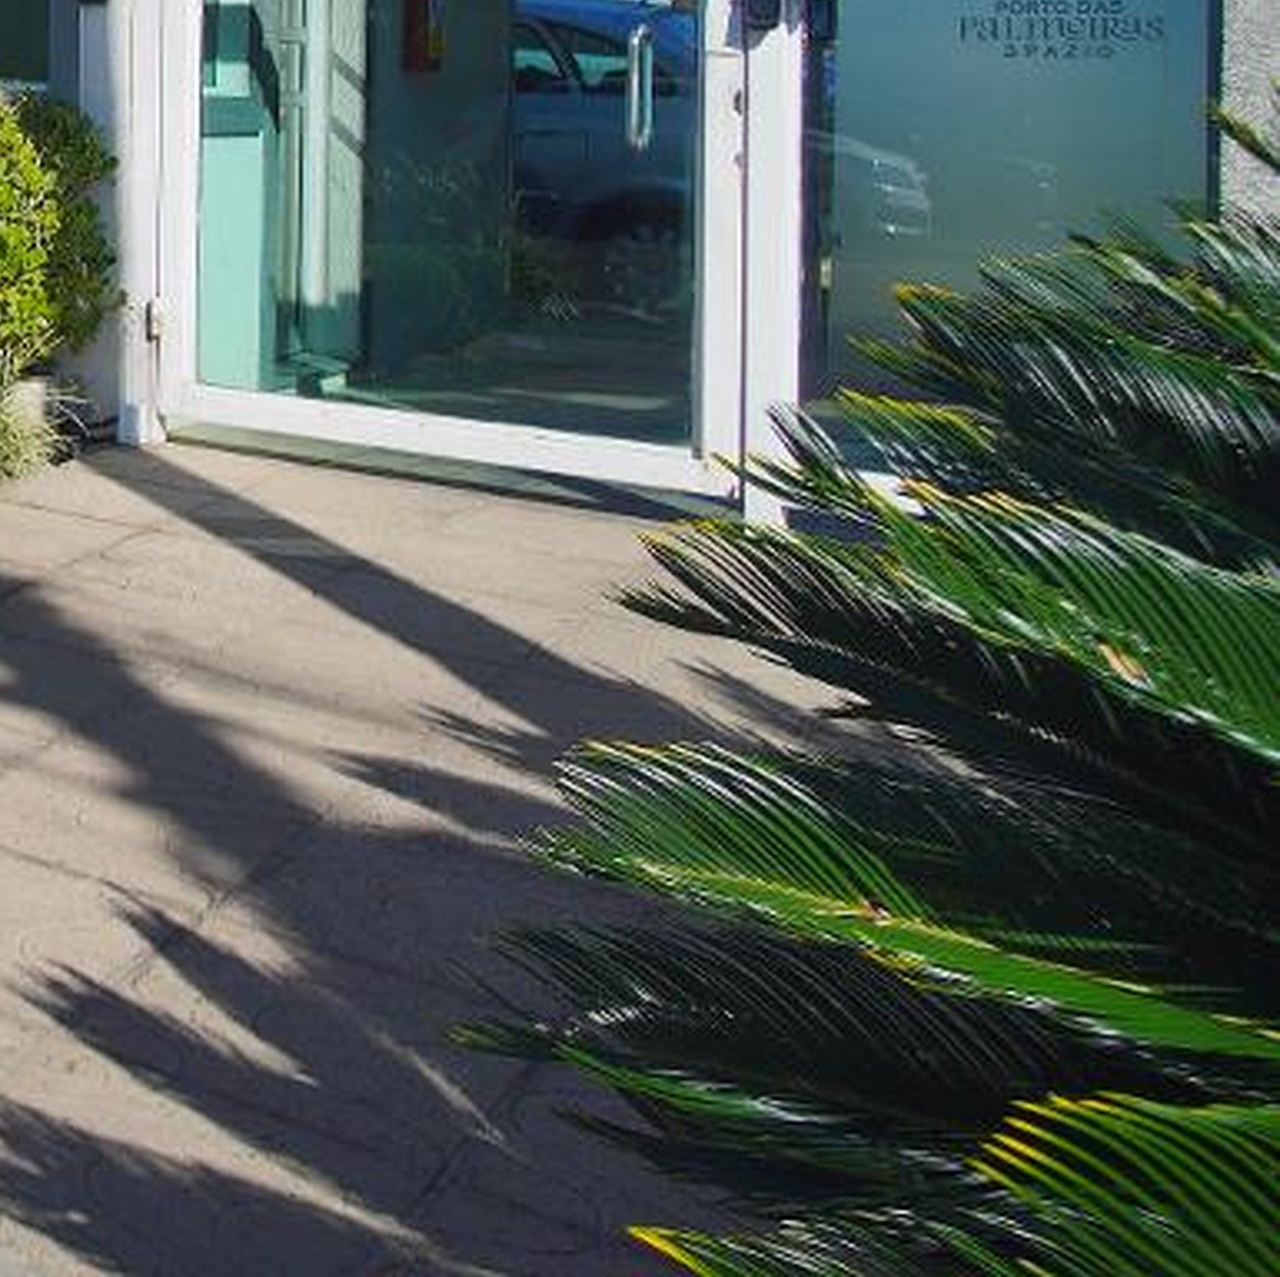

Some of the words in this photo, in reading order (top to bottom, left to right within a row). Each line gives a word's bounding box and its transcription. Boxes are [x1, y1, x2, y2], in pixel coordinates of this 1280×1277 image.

[995, 0, 1069, 16] PORTO
[1075, 0, 1124, 16] DAS
[1002, 43, 1116, 60] SPAZIO
